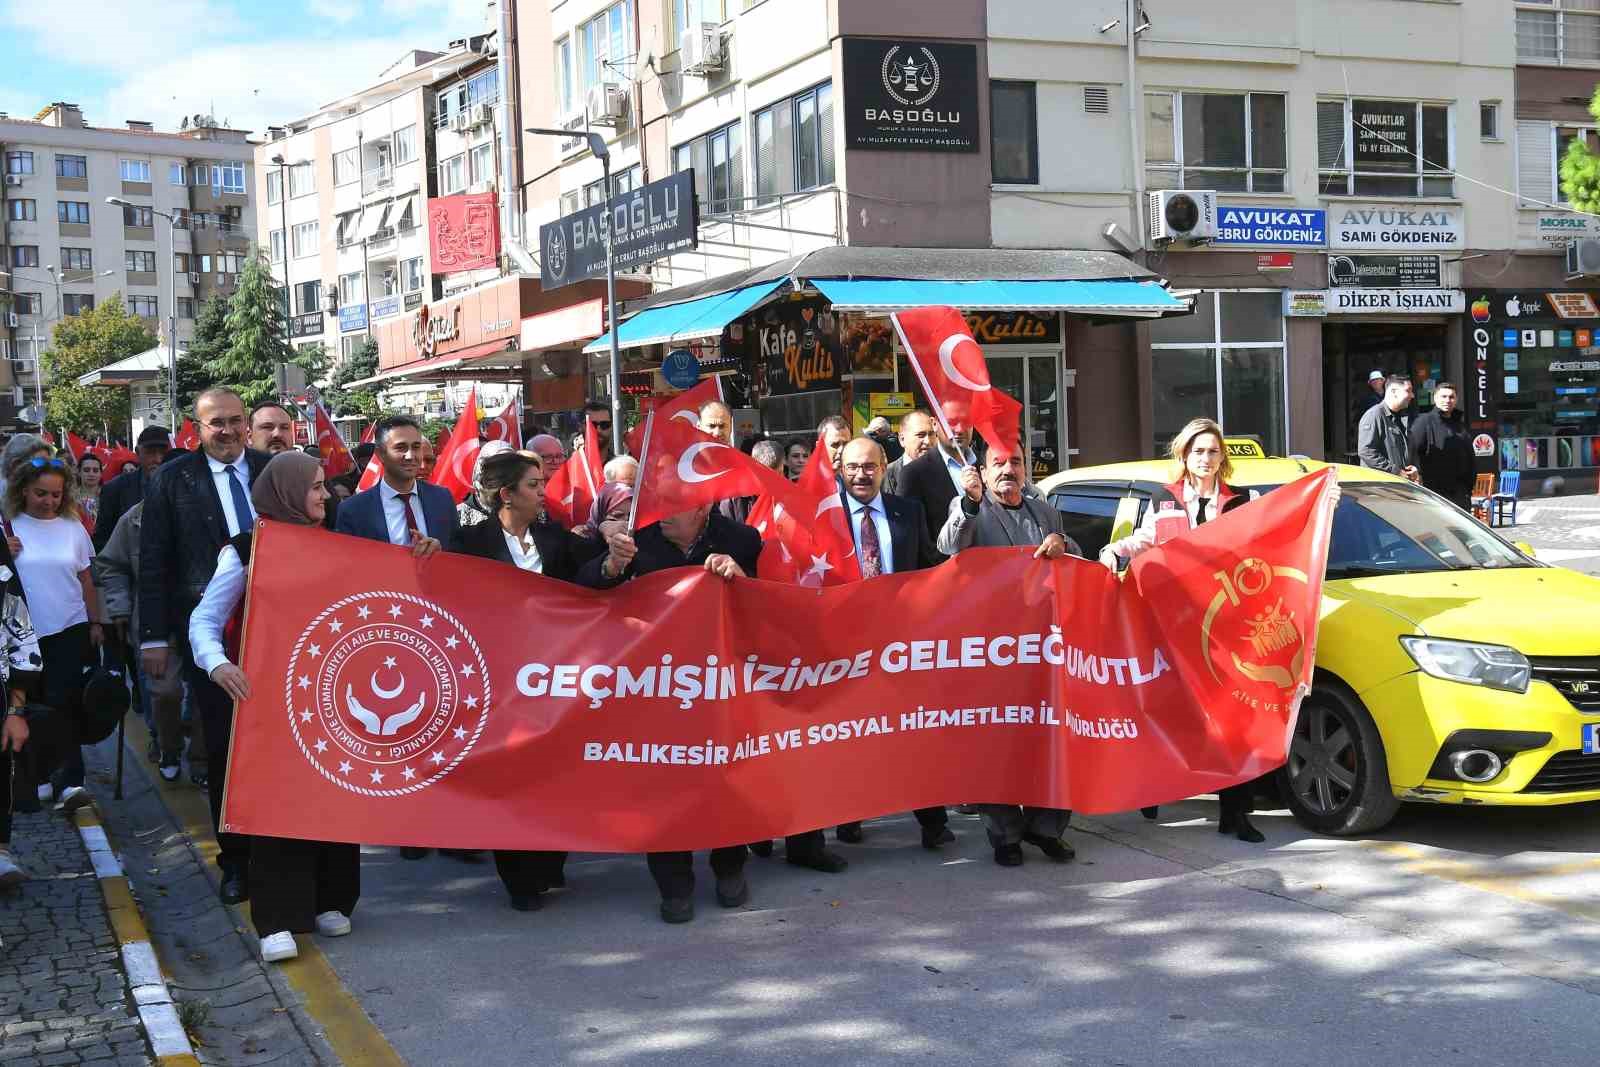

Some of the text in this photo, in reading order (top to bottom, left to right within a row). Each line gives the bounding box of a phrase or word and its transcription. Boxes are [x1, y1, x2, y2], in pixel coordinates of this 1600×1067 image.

[865, 108, 960, 124] BAŞOĞLU
[1361, 113, 1405, 127] AVUKATLAR
[573, 184, 679, 249] BAŞOĞLU
[1223, 211, 1315, 226] AVUKAT
[1340, 210, 1454, 226] AVUKAT
[1217, 226, 1322, 242] EBRU GÖKDENİZ
[1339, 291, 1391, 308] DİKER
[1396, 291, 1452, 310] İŞHANI
[971, 315, 1048, 339] Kulis
[759, 324, 797, 357] Kafe
[516, 654, 736, 710] GEÇMİŞİN
[743, 650, 873, 694] İZİNDE
[1066, 644, 1171, 686] UMUTLA
[321, 629, 452, 758] TÜRKİYE CUMHURİYETİ AİLE VE SOSYAL HİZMETLER BAKANLIĞI
[1263, 702, 1280, 712] VE
[583, 739, 728, 765] BALIKESİR
[732, 733, 771, 762] AİLE
[773, 728, 802, 750] VE
[807, 716, 894, 745] SOSYAL
[899, 705, 1035, 732] HİZMETLER
[1039, 700, 1060, 725] İL
